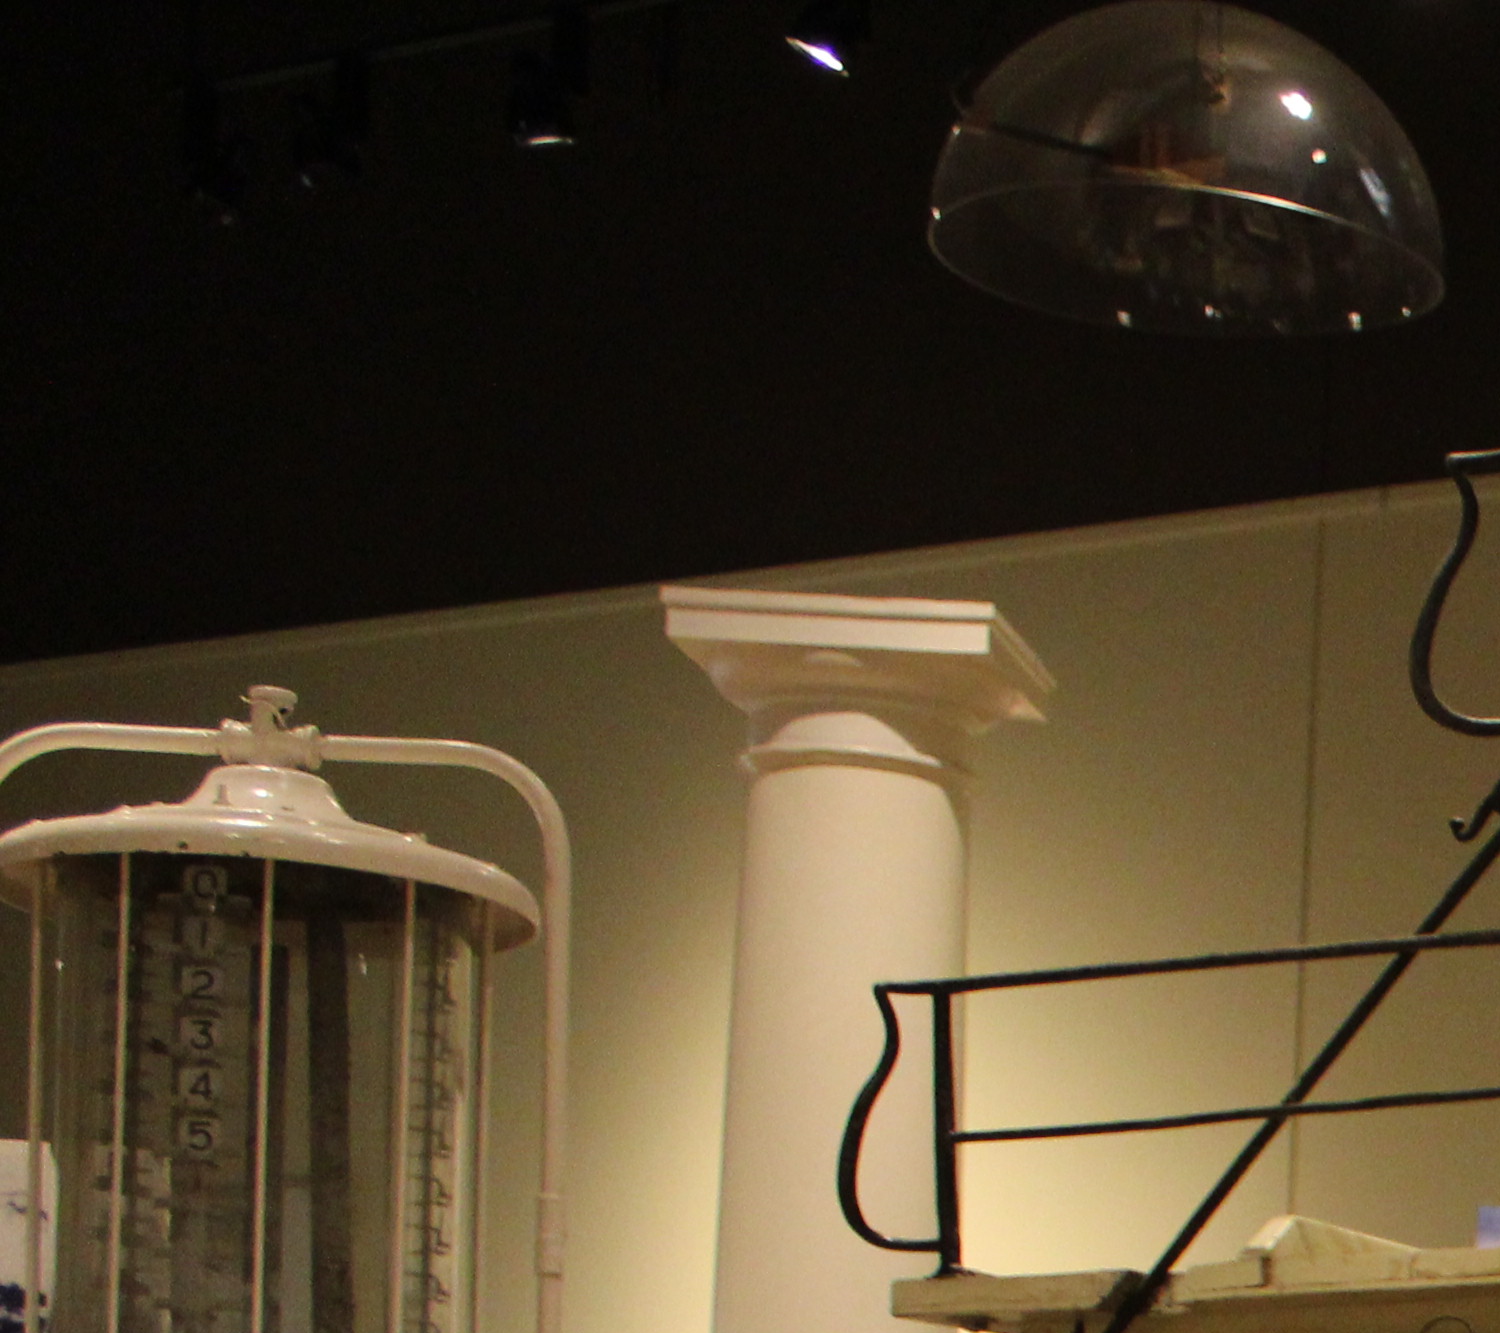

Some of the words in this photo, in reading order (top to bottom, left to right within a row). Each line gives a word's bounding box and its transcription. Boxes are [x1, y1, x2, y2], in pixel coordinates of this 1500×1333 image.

[191, 969, 214, 999] 2
[191, 1019, 214, 1050] 3
[190, 1072, 212, 1099] 4
[188, 1120, 213, 1150] 5
